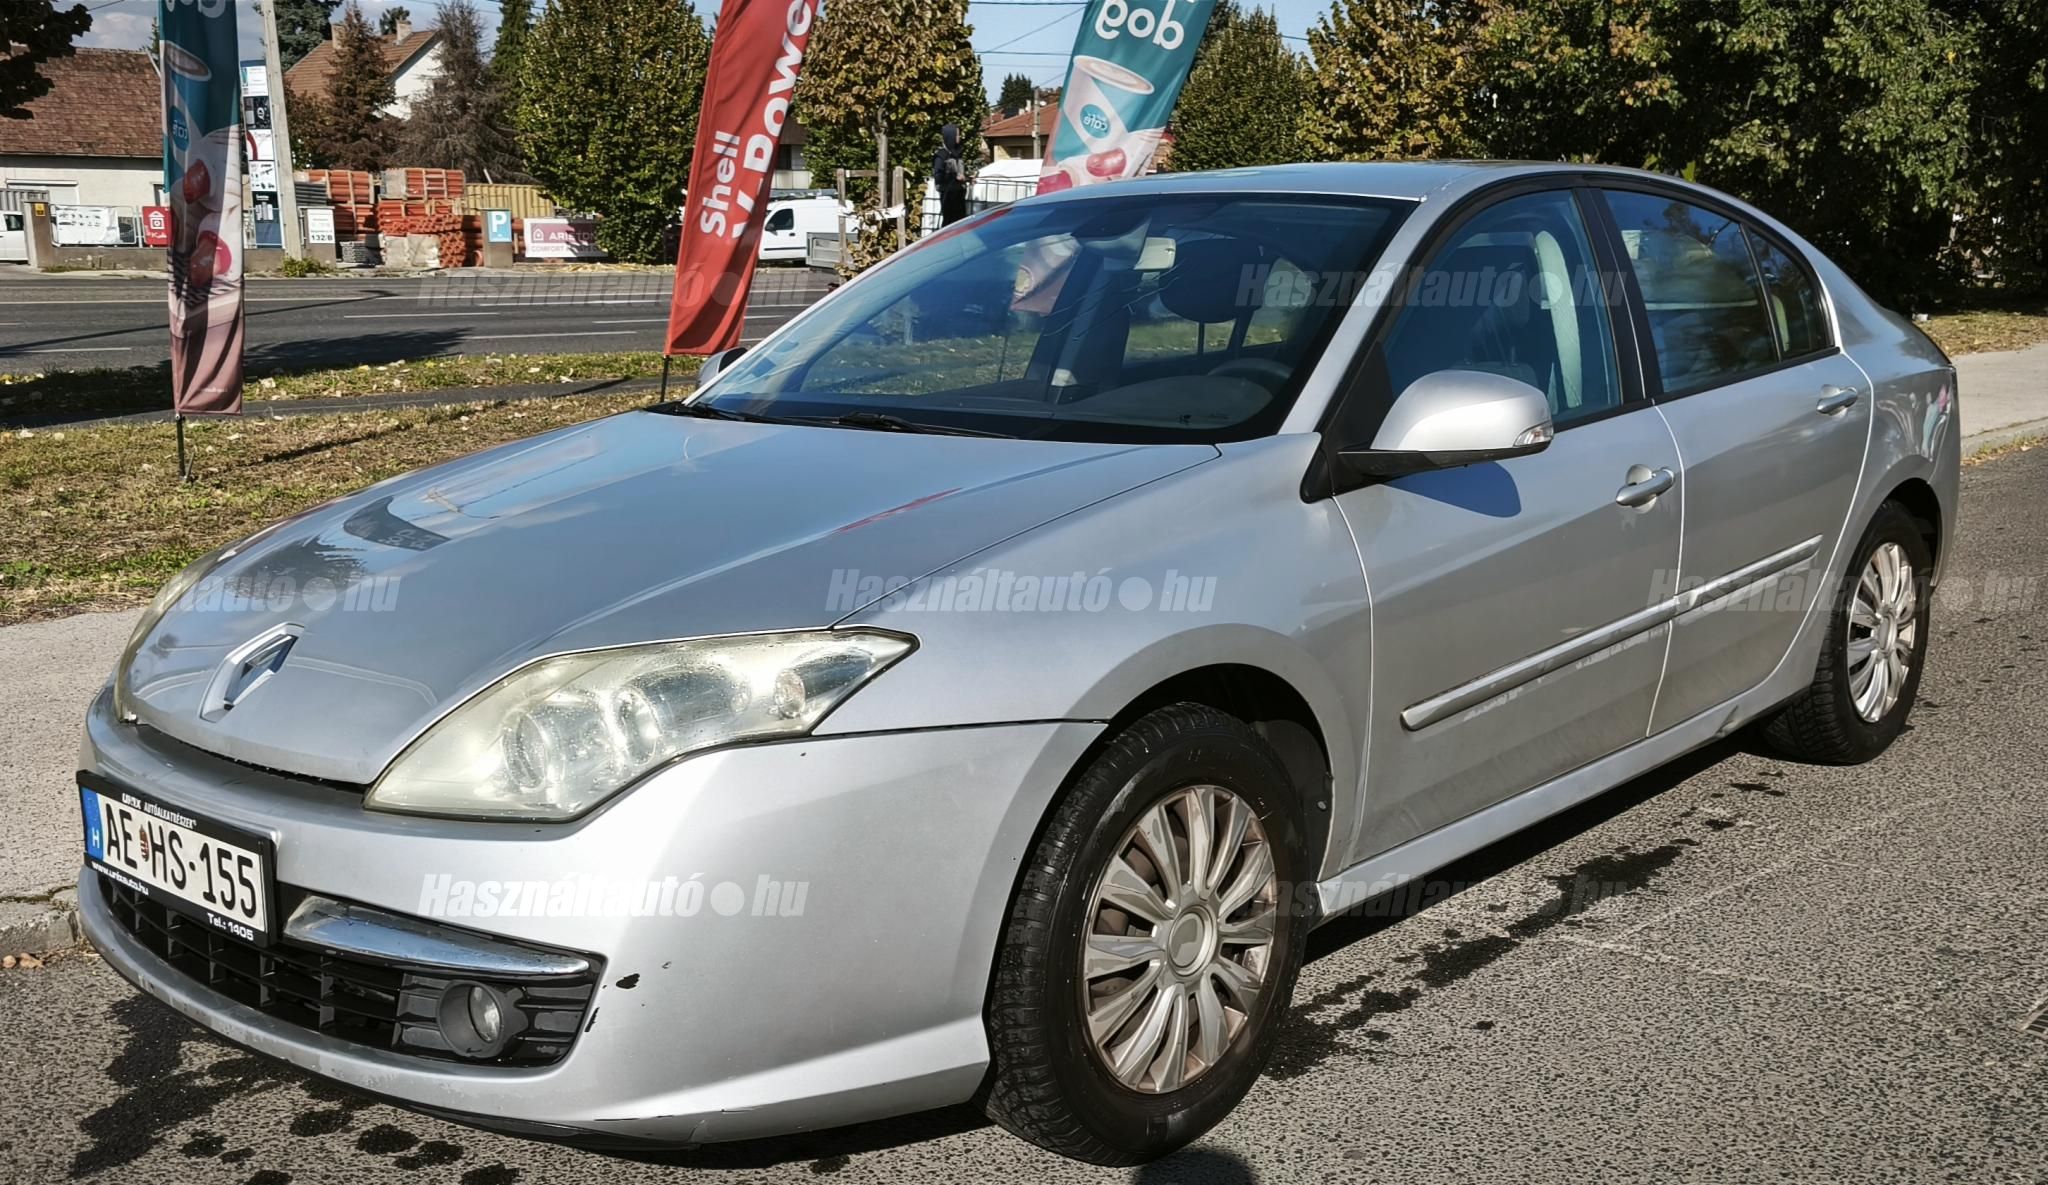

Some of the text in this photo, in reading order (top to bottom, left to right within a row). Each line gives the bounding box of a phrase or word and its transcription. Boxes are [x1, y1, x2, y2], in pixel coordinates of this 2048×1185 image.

[700, 131, 740, 238] Shell
[490, 210, 508, 233] P
[92, 826, 100, 849] H
[106, 802, 138, 870] AE
[228, 921, 254, 942] 1405
